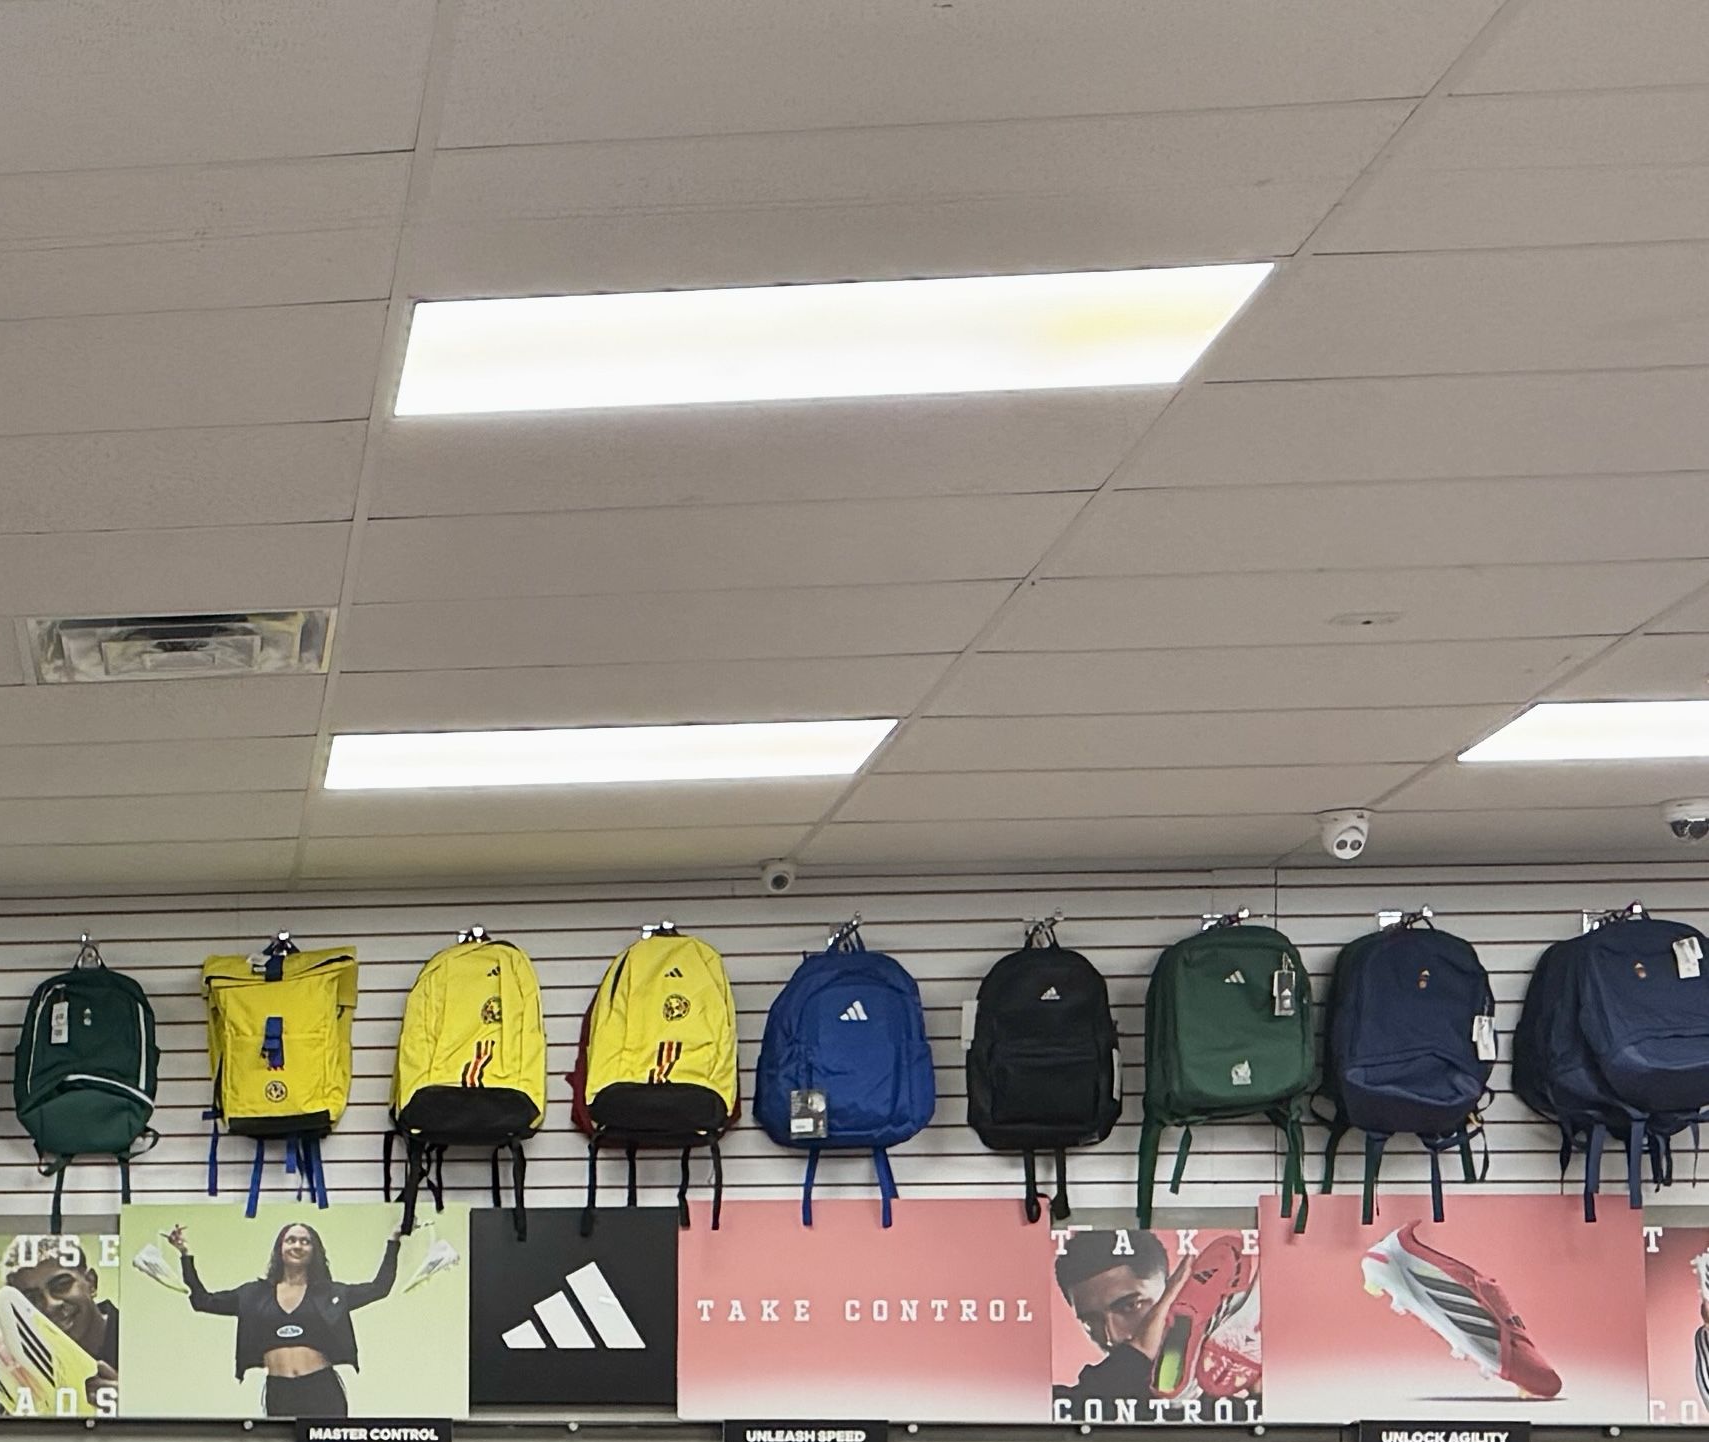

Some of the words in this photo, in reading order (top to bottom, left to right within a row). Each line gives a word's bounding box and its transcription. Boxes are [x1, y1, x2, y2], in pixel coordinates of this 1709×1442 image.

[1051, 1228, 1260, 1256] TAKE
[697, 1299, 811, 1322] TAKE
[844, 1299, 1033, 1322] CONTROL
[1053, 1397, 1264, 1423] CONTROL
[309, 1427, 368, 1441] MASTER
[369, 1427, 439, 1441] CONTROL
[745, 1429, 816, 1442] UNLEASH
[817, 1429, 867, 1442] SPEED
